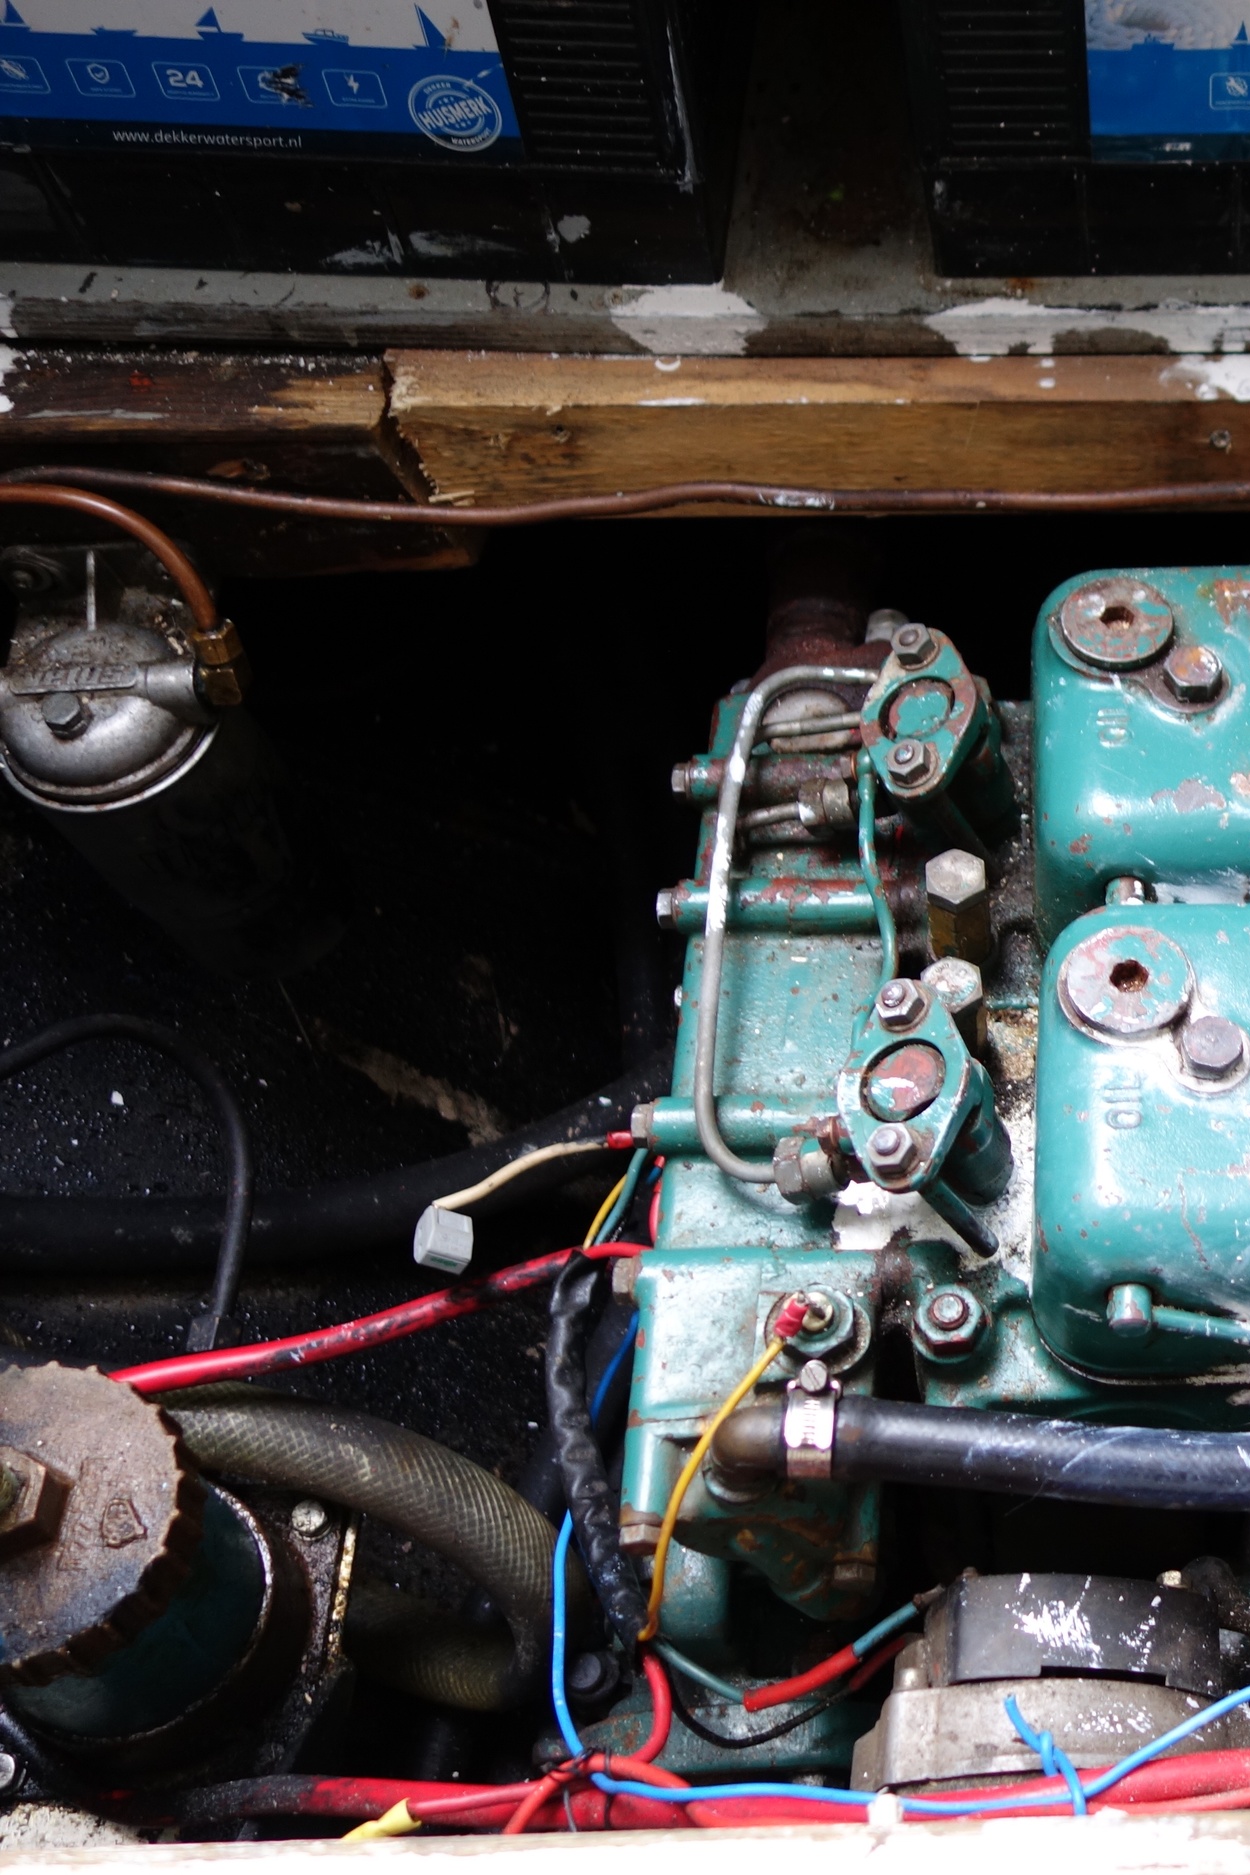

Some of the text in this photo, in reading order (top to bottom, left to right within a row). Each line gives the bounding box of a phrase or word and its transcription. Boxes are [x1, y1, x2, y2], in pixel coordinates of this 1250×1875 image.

[166, 69, 204, 88] 24
[418, 95, 493, 131] HUISMERK
[112, 129, 302, 148] www.dekkerwatersport.nl
